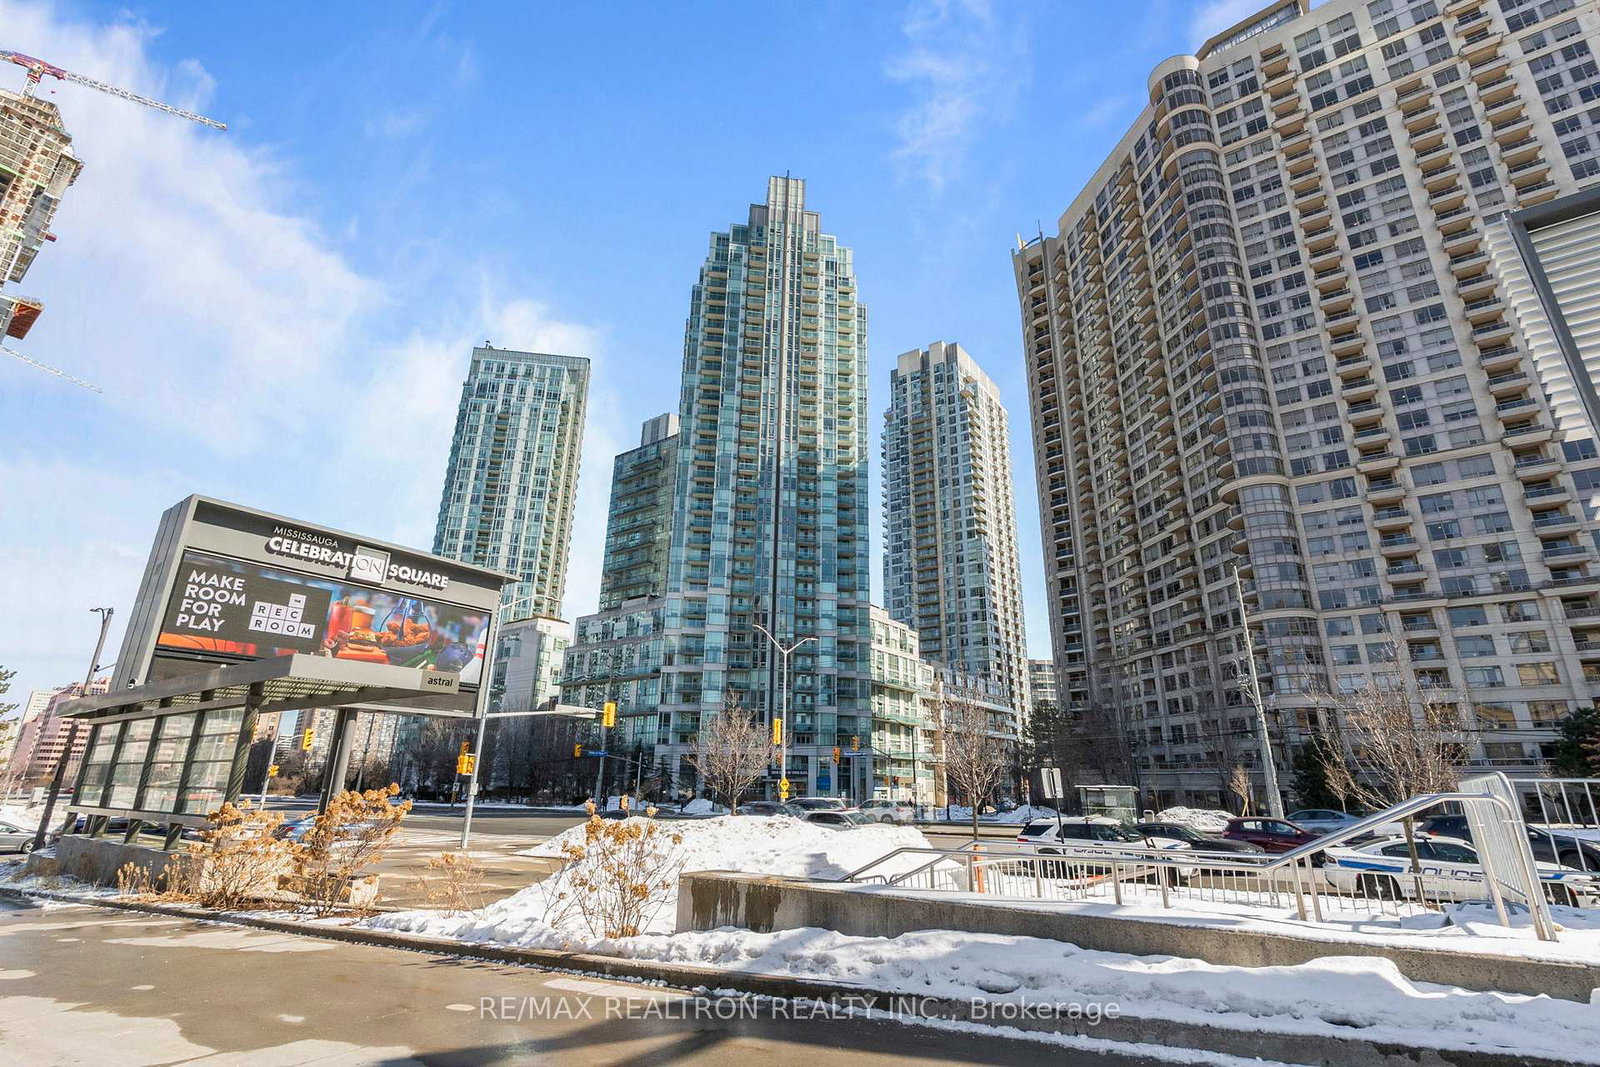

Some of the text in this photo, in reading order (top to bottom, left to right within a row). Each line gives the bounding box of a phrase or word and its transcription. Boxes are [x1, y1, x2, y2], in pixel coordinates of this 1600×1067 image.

[274, 526, 339, 549] MISSISSAUGA
[188, 569, 246, 591] MAKE
[389, 564, 450, 588] SQUARE
[184, 584, 246, 606] ROOM
[180, 598, 222, 617] FOR
[258, 605, 299, 619] REC
[176, 613, 226, 632] PLAY
[254, 619, 311, 636] ROOM
[427, 677, 454, 687] astral
